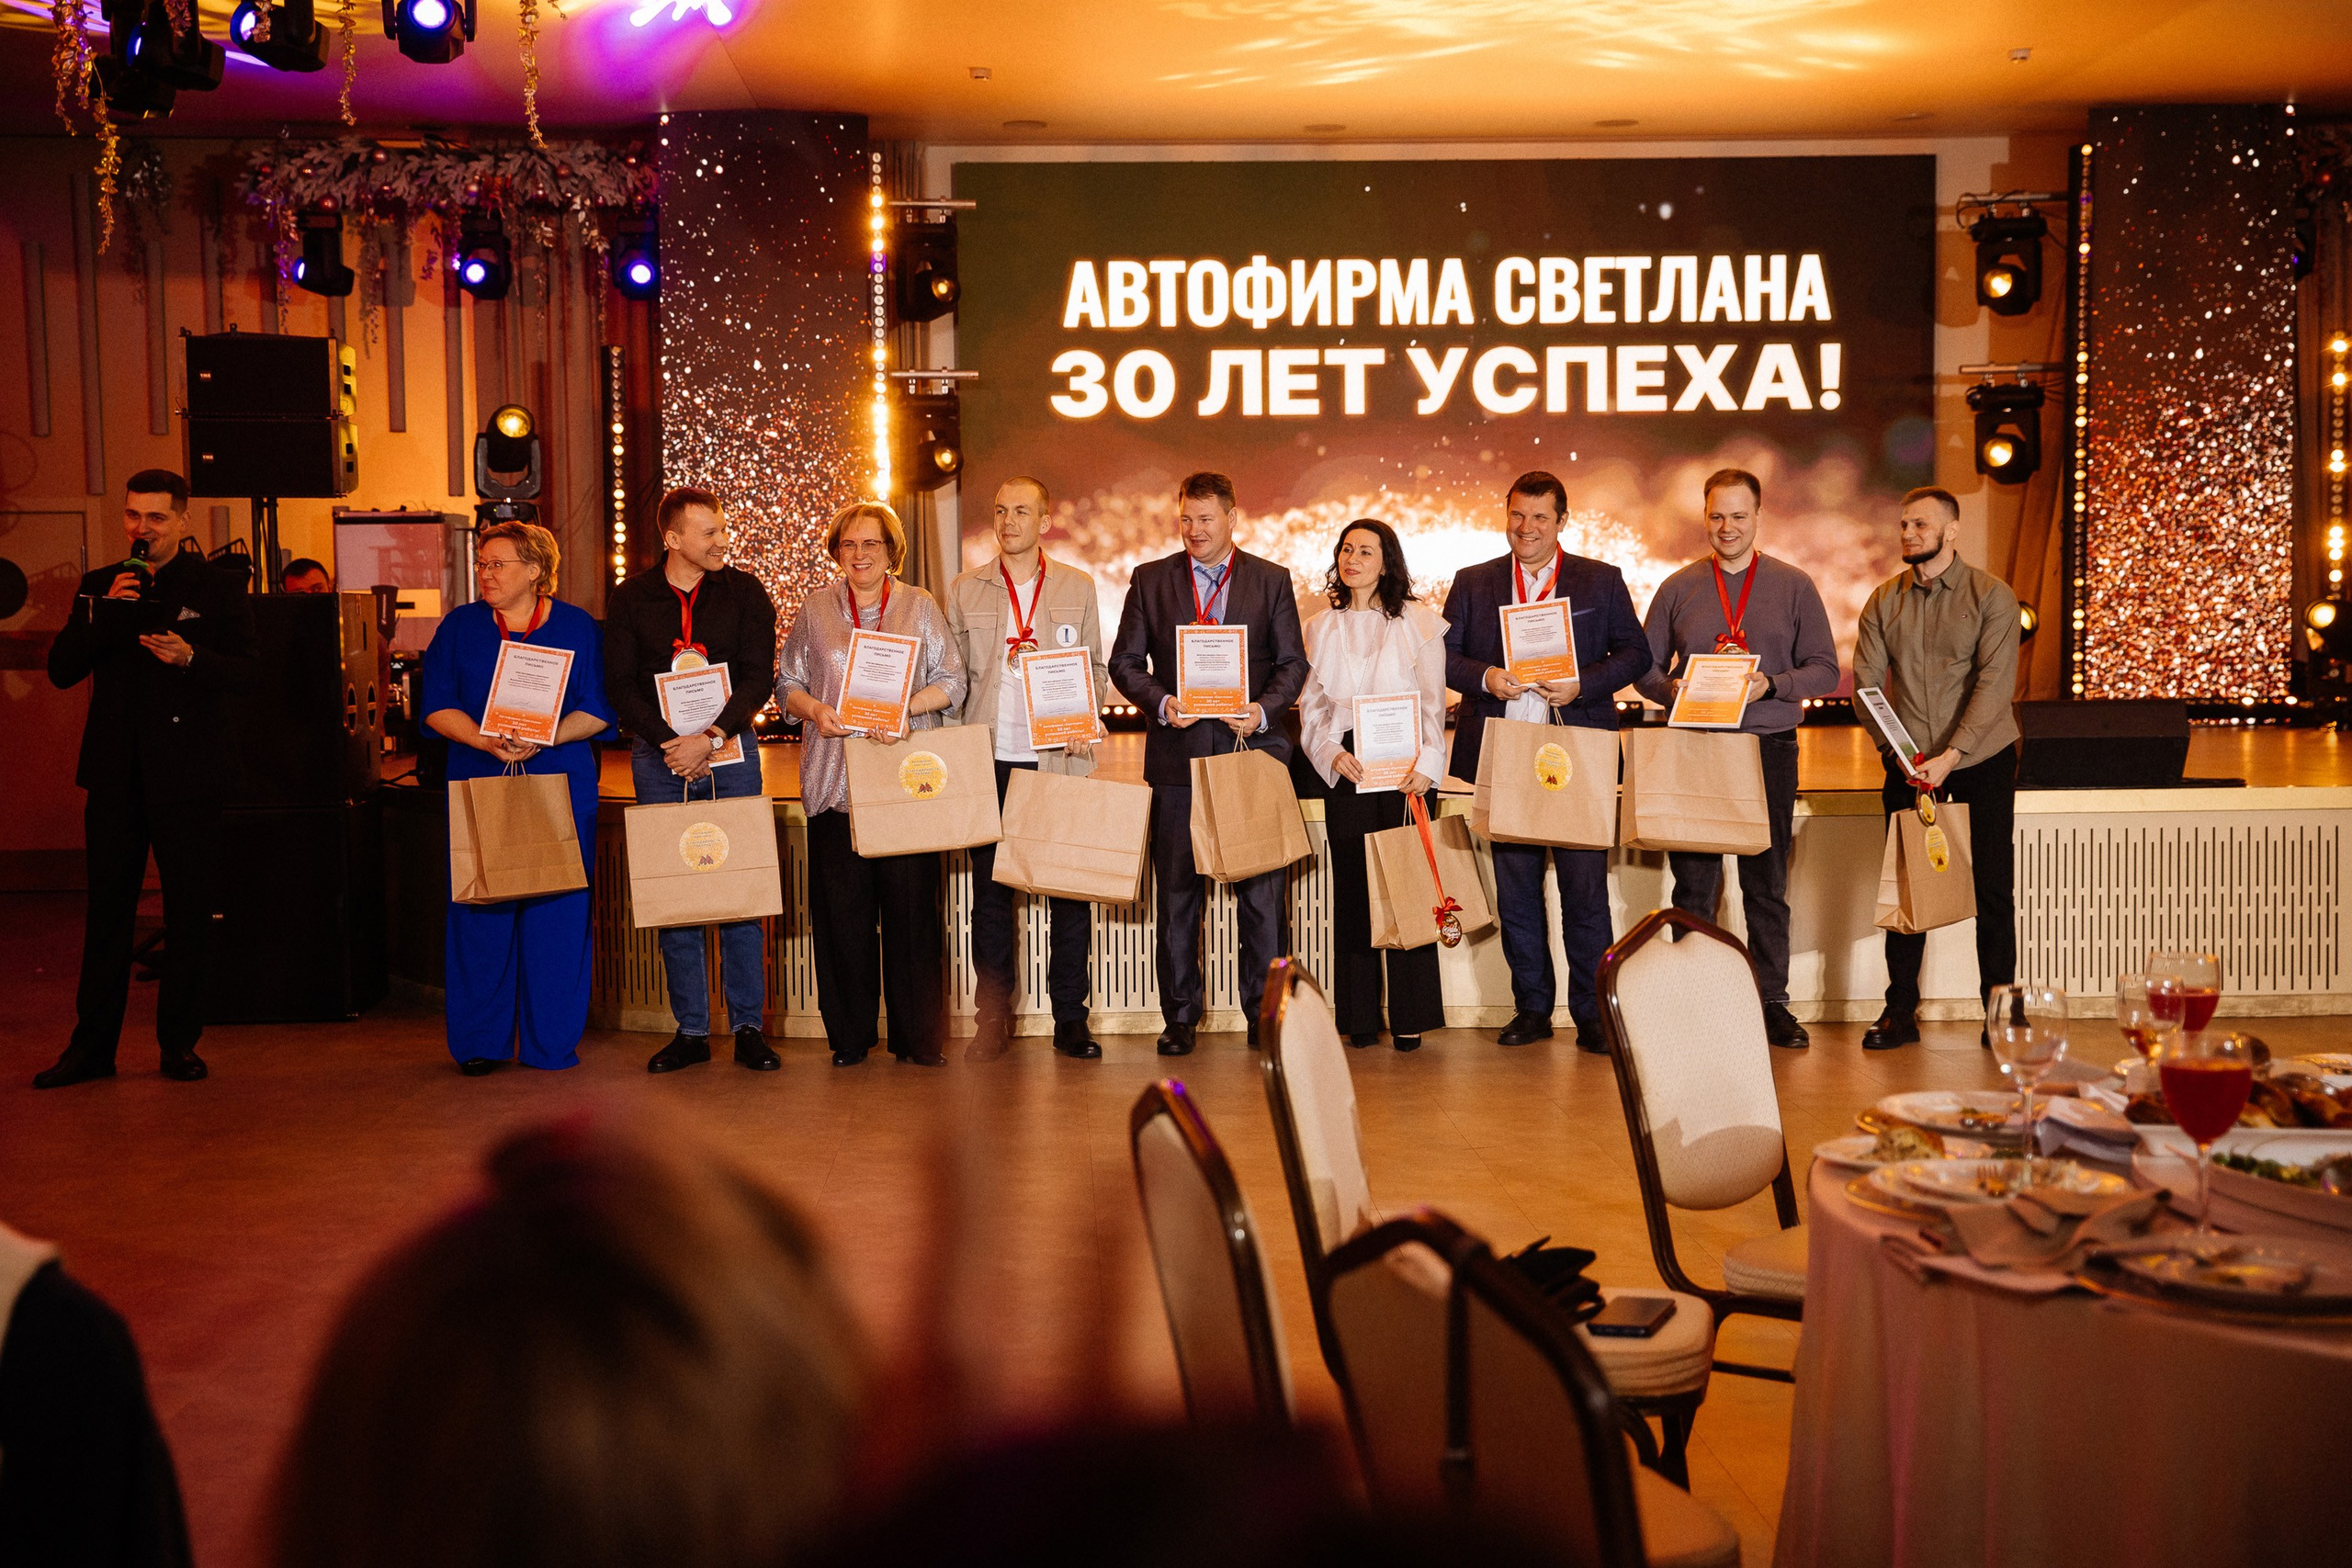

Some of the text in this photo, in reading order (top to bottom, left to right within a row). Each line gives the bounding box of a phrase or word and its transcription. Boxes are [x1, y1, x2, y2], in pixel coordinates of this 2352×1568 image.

[1064, 254, 1830, 328] АВТОФИРМА СВЕТЛАНА
[1051, 341, 1840, 417] 30 ЛЕТ УСПЕХА!
[864, 645, 904, 655] БЛАГОДАРСТВЕННОЕ
[514, 655, 559, 666] БЛАГОДАРСТВЕННОЕ
[1035, 661, 1078, 671] БЛАГОДАРСТВЕННОЕ
[673, 680, 717, 691] БЛАГОДАРСТВЕННОЕ
